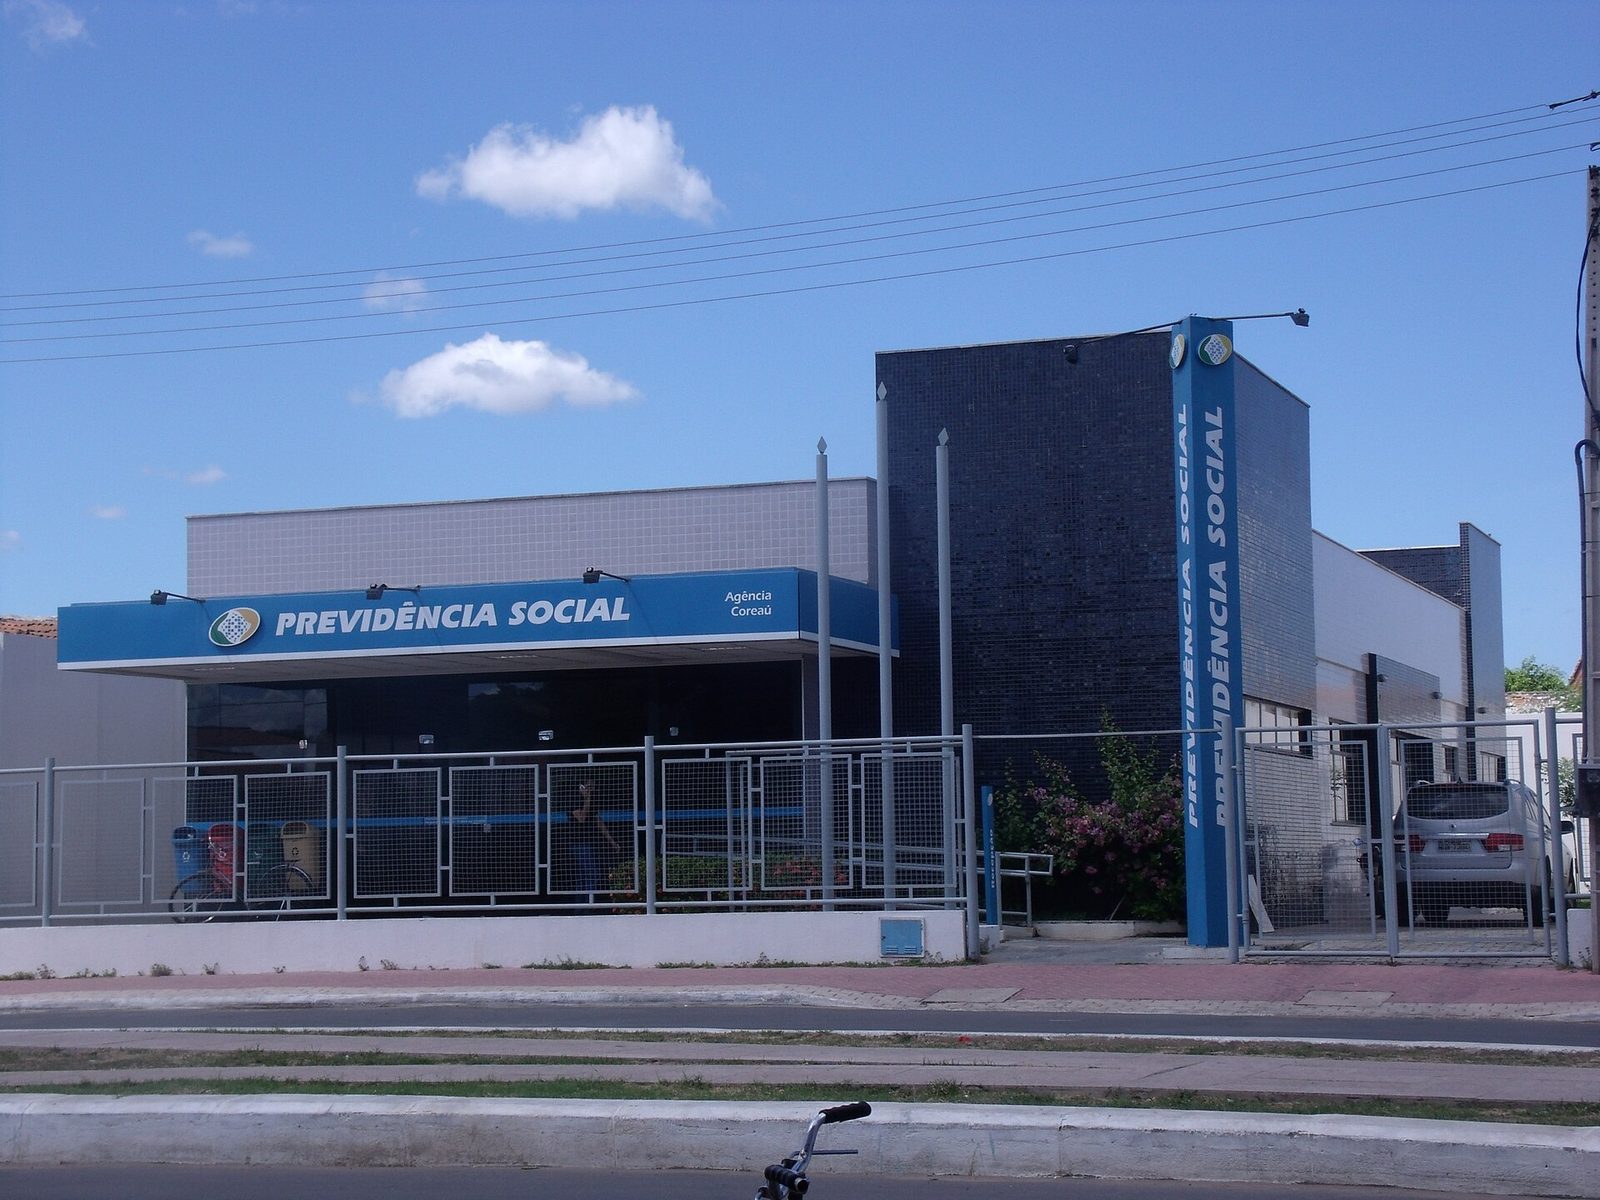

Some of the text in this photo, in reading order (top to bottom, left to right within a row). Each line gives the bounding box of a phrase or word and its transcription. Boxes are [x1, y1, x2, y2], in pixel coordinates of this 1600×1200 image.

[1205, 406, 1226, 546] SOCIAL
[276, 596, 630, 636] PREVIDÊNCIA SOCIAL
[724, 590, 772, 604] Agência
[731, 605, 772, 617] Coreaú
[1178, 404, 1198, 828] PREVIDÊNCIA SOCIAL
